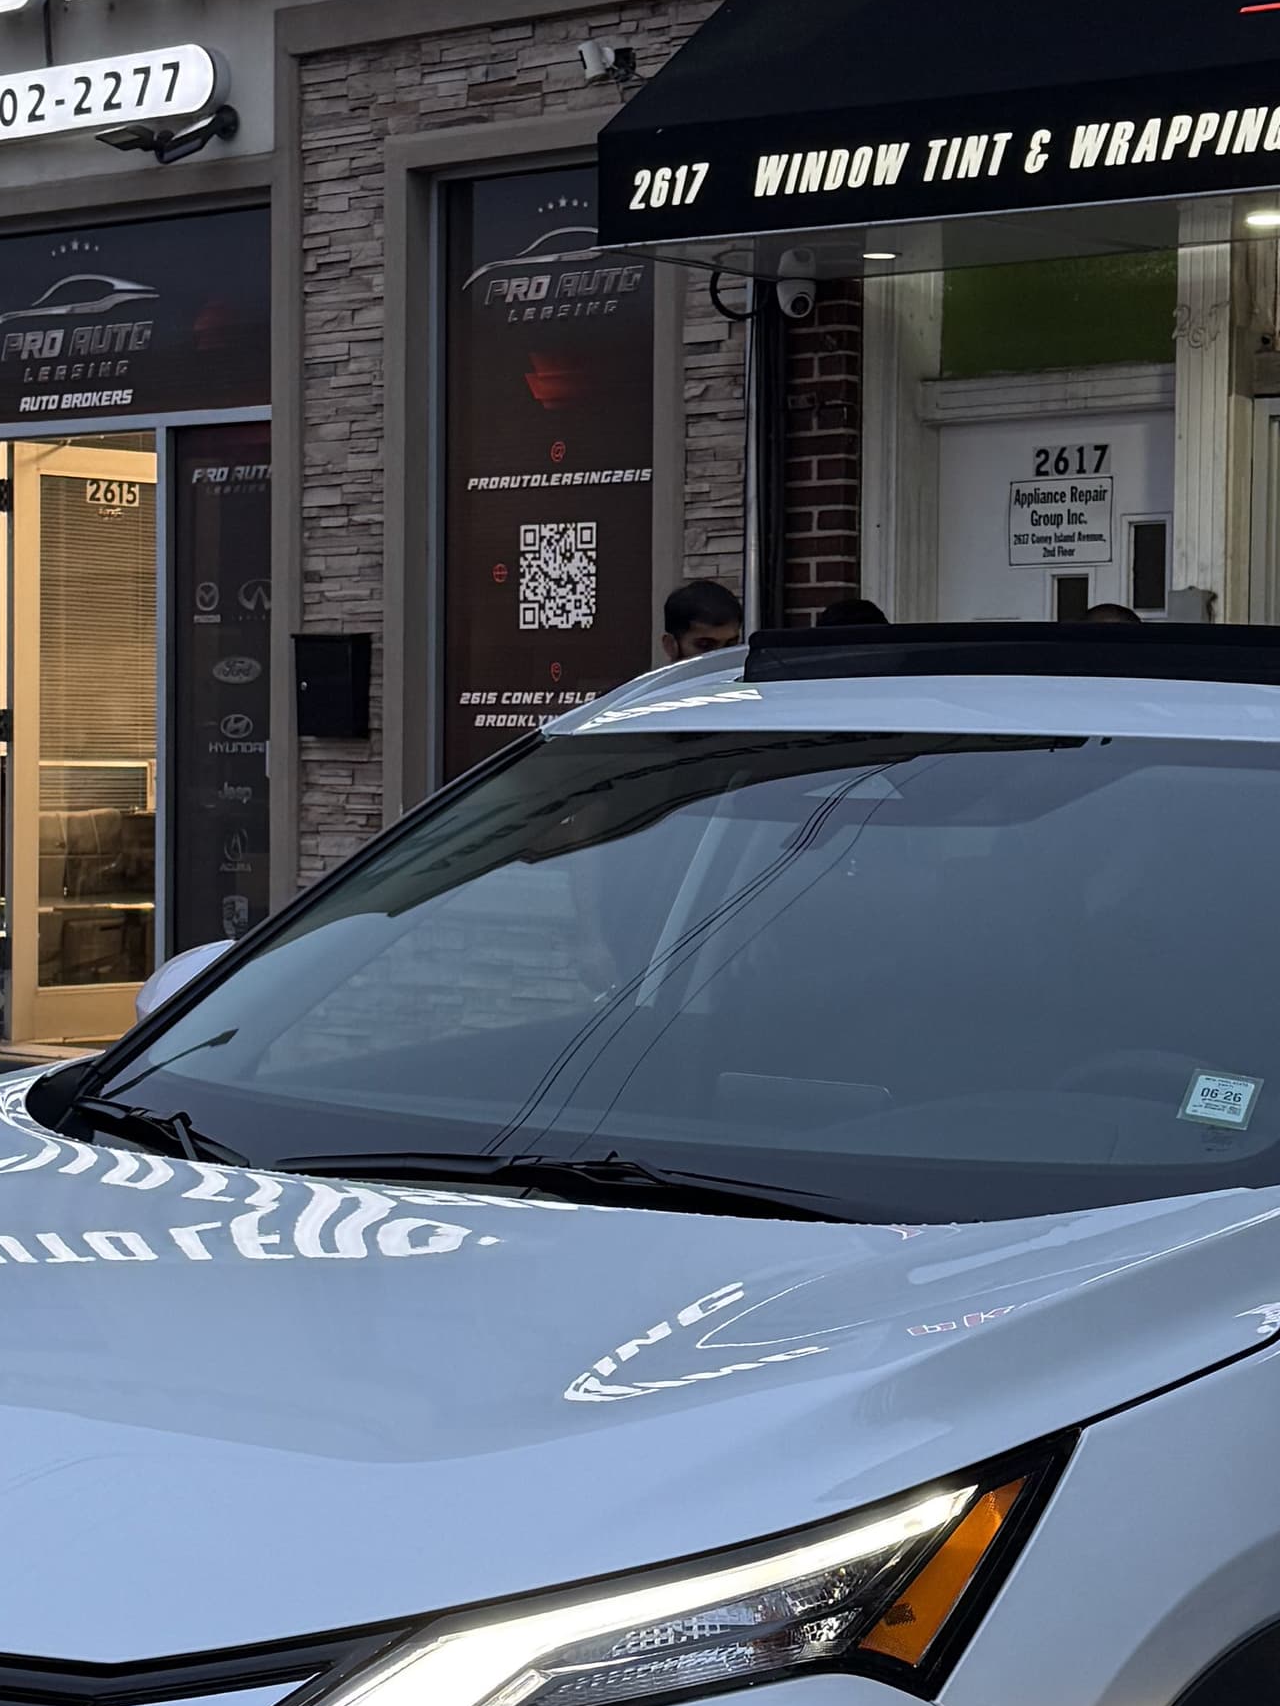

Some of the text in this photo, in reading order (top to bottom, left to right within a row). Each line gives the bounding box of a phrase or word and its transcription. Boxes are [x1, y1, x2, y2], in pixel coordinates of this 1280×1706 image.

[628, 161, 710, 212] 2617
[752, 138, 911, 199] WINDOW
[922, 132, 1013, 184] TINT
[1024, 128, 1051, 174] &
[485, 265, 645, 305] PRO AUTO
[1, 321, 154, 362] PRO AUTO
[24, 360, 130, 384] LEASING
[19, 389, 133, 412] AUTO BROKERS
[1035, 445, 1108, 476] 2617
[192, 465, 271, 483] PRO AUT
[467, 468, 653, 491] PROAUTOLEASING2615
[87, 480, 138, 505] 2615
[1014, 485, 1108, 508] Appliance Repair
[1031, 509, 1088, 528] Group Inc.
[459, 691, 596, 705] 2615 CONEY ISLA
[1201, 1088, 1242, 1102] 06 26
